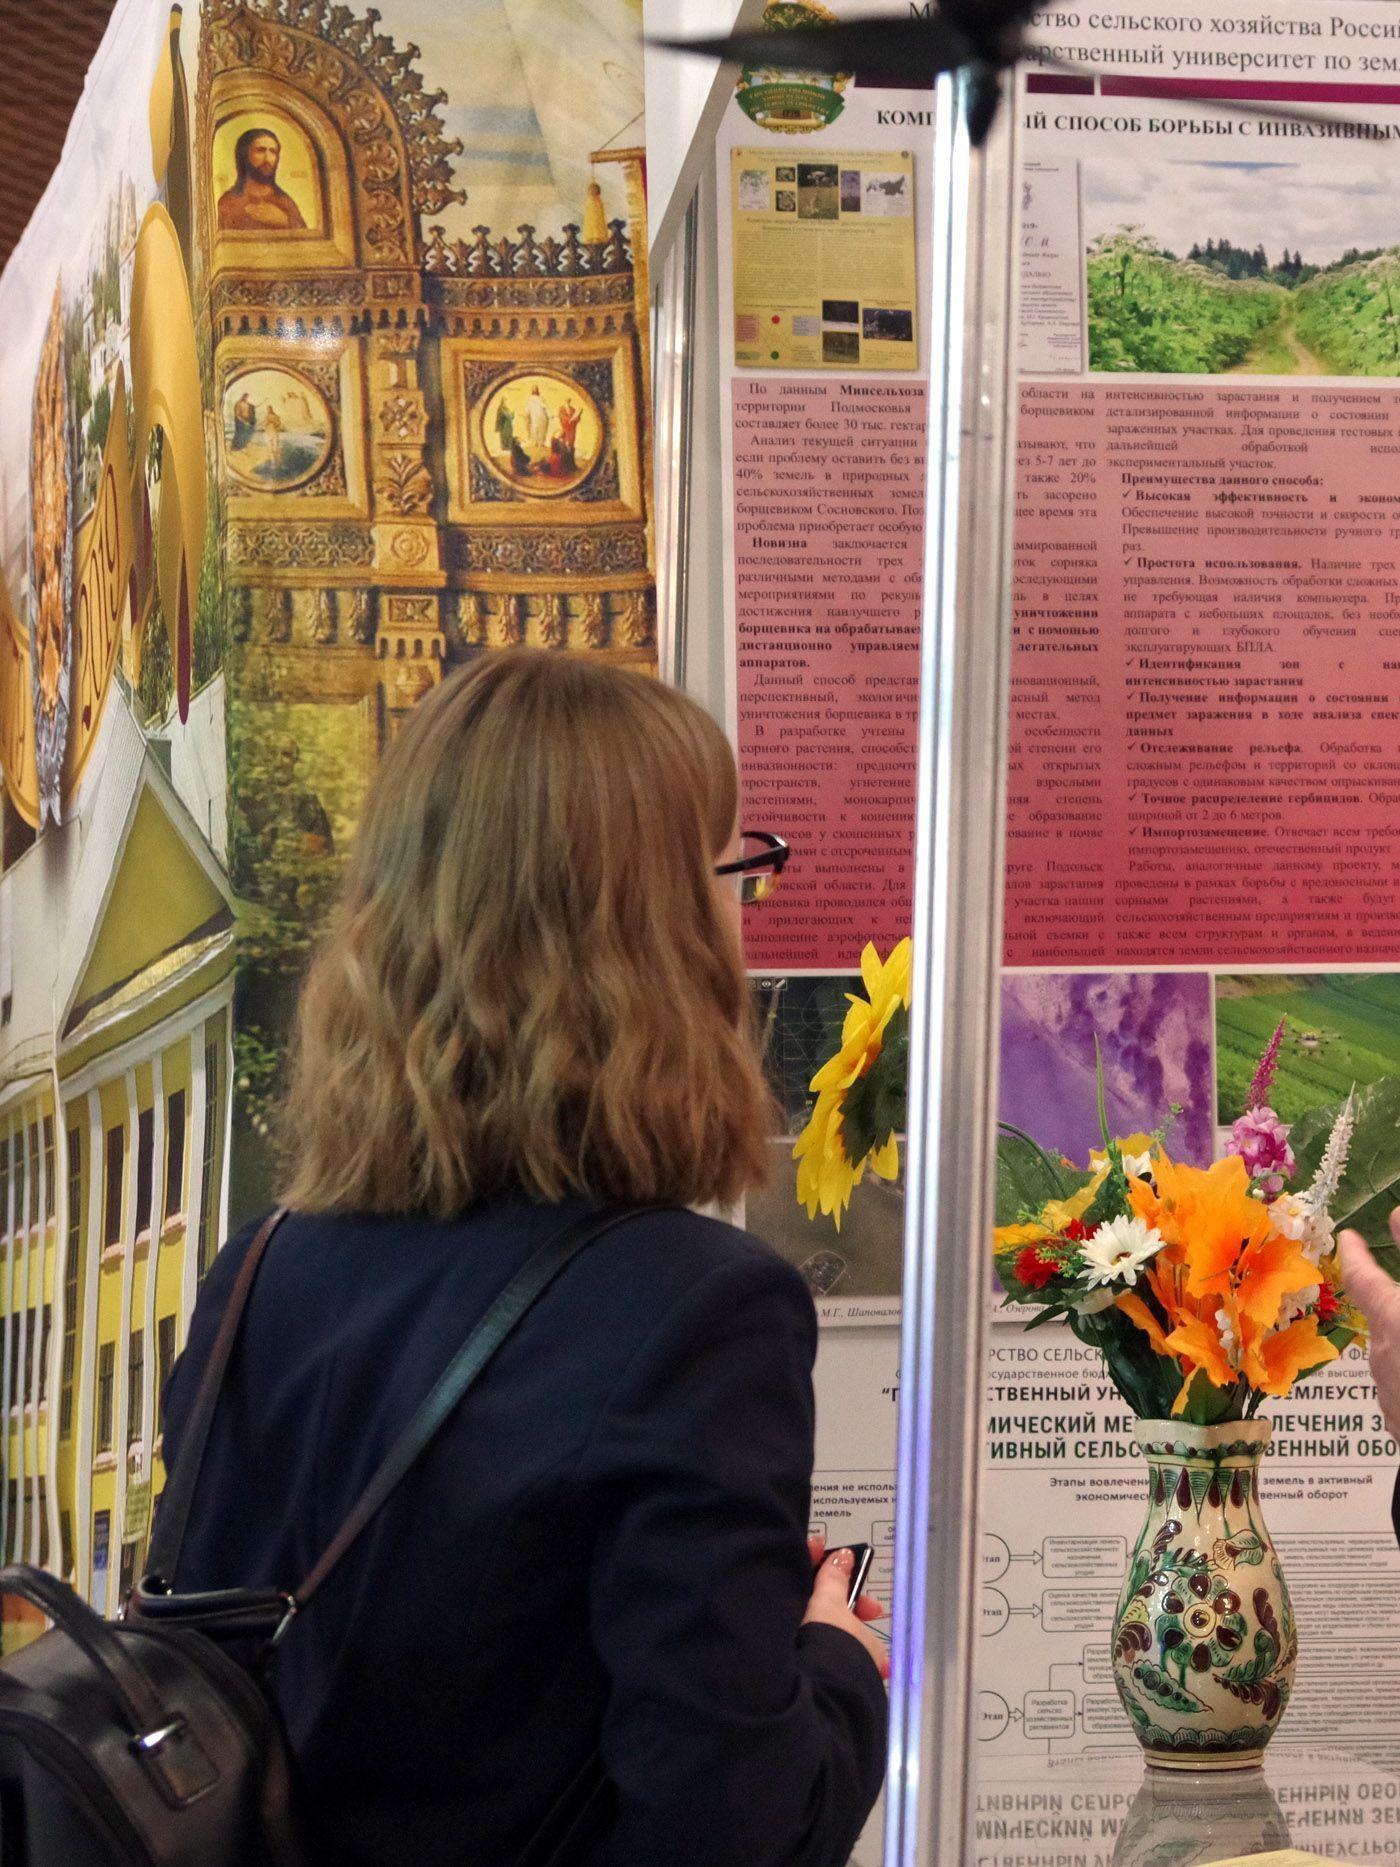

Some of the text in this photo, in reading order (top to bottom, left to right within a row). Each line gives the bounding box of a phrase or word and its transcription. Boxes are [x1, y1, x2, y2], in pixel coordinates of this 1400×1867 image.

[1088, 12, 1203, 34] сельского
[1209, 16, 1321, 38] хозяйства
[1172, 48, 1315, 75] университет
[1325, 55, 1351, 71] по
[1055, 115, 1142, 133] СПОСОБ
[1149, 118, 1233, 135] БОРЬБЫ
[1239, 121, 1252, 136] С
[749, 382, 924, 396] По данным Минсельхоза
[1021, 387, 1068, 399] области
[736, 401, 911, 414] территории Подмосковья
[1020, 404, 1094, 416] борщевиком
[1106, 407, 1214, 419] детализированной
[735, 417, 886, 430] составляет более 30 тыс.
[750, 435, 917, 449] Анализ текущей ситуации
[735, 452, 909, 466] если проблему оставить без
[1106, 457, 1225, 469] экспериментальный
[736, 468, 909, 482] 40% земель природных
[1121, 472, 1324, 486] Преимущества данного способа:
[736, 486, 874, 497] сельскохозяйственных
[1136, 490, 1191, 501] Высокая
[1213, 489, 1308, 504] эффективность
[737, 502, 897, 515] борщевиком Сосновского.
[753, 536, 907, 548] Новизна заключается
[738, 555, 862, 565] последовательности
[1137, 557, 1302, 570] Простота использования.
[738, 573, 880, 583] различными методами
[738, 590, 834, 601] мероприятиями
[738, 607, 900, 618] достижения наилучшего
[739, 623, 811, 636] борщевика
[738, 641, 832, 651] дистанционно
[739, 657, 810, 669] аппаратов.
[1139, 658, 1242, 671] Идентификация
[1139, 691, 1298, 706] Получение информации
[1140, 741, 1233, 754] Отслеживание
[1142, 792, 1362, 806] Точное распределение гербицидов.
[821, 1306, 845, 1318] М.Г.,
[1258, 1415, 1363, 1432] ЛЕЧЕНИЯ
[987, 1437, 1066, 1459] ИВНЫЙ
[1050, 1474, 1373, 1488] Этапы земель активный
[813, 1495, 889, 1507] используемых
[1307, 1489, 1348, 1501] оборот
[814, 1509, 852, 1519] земель
